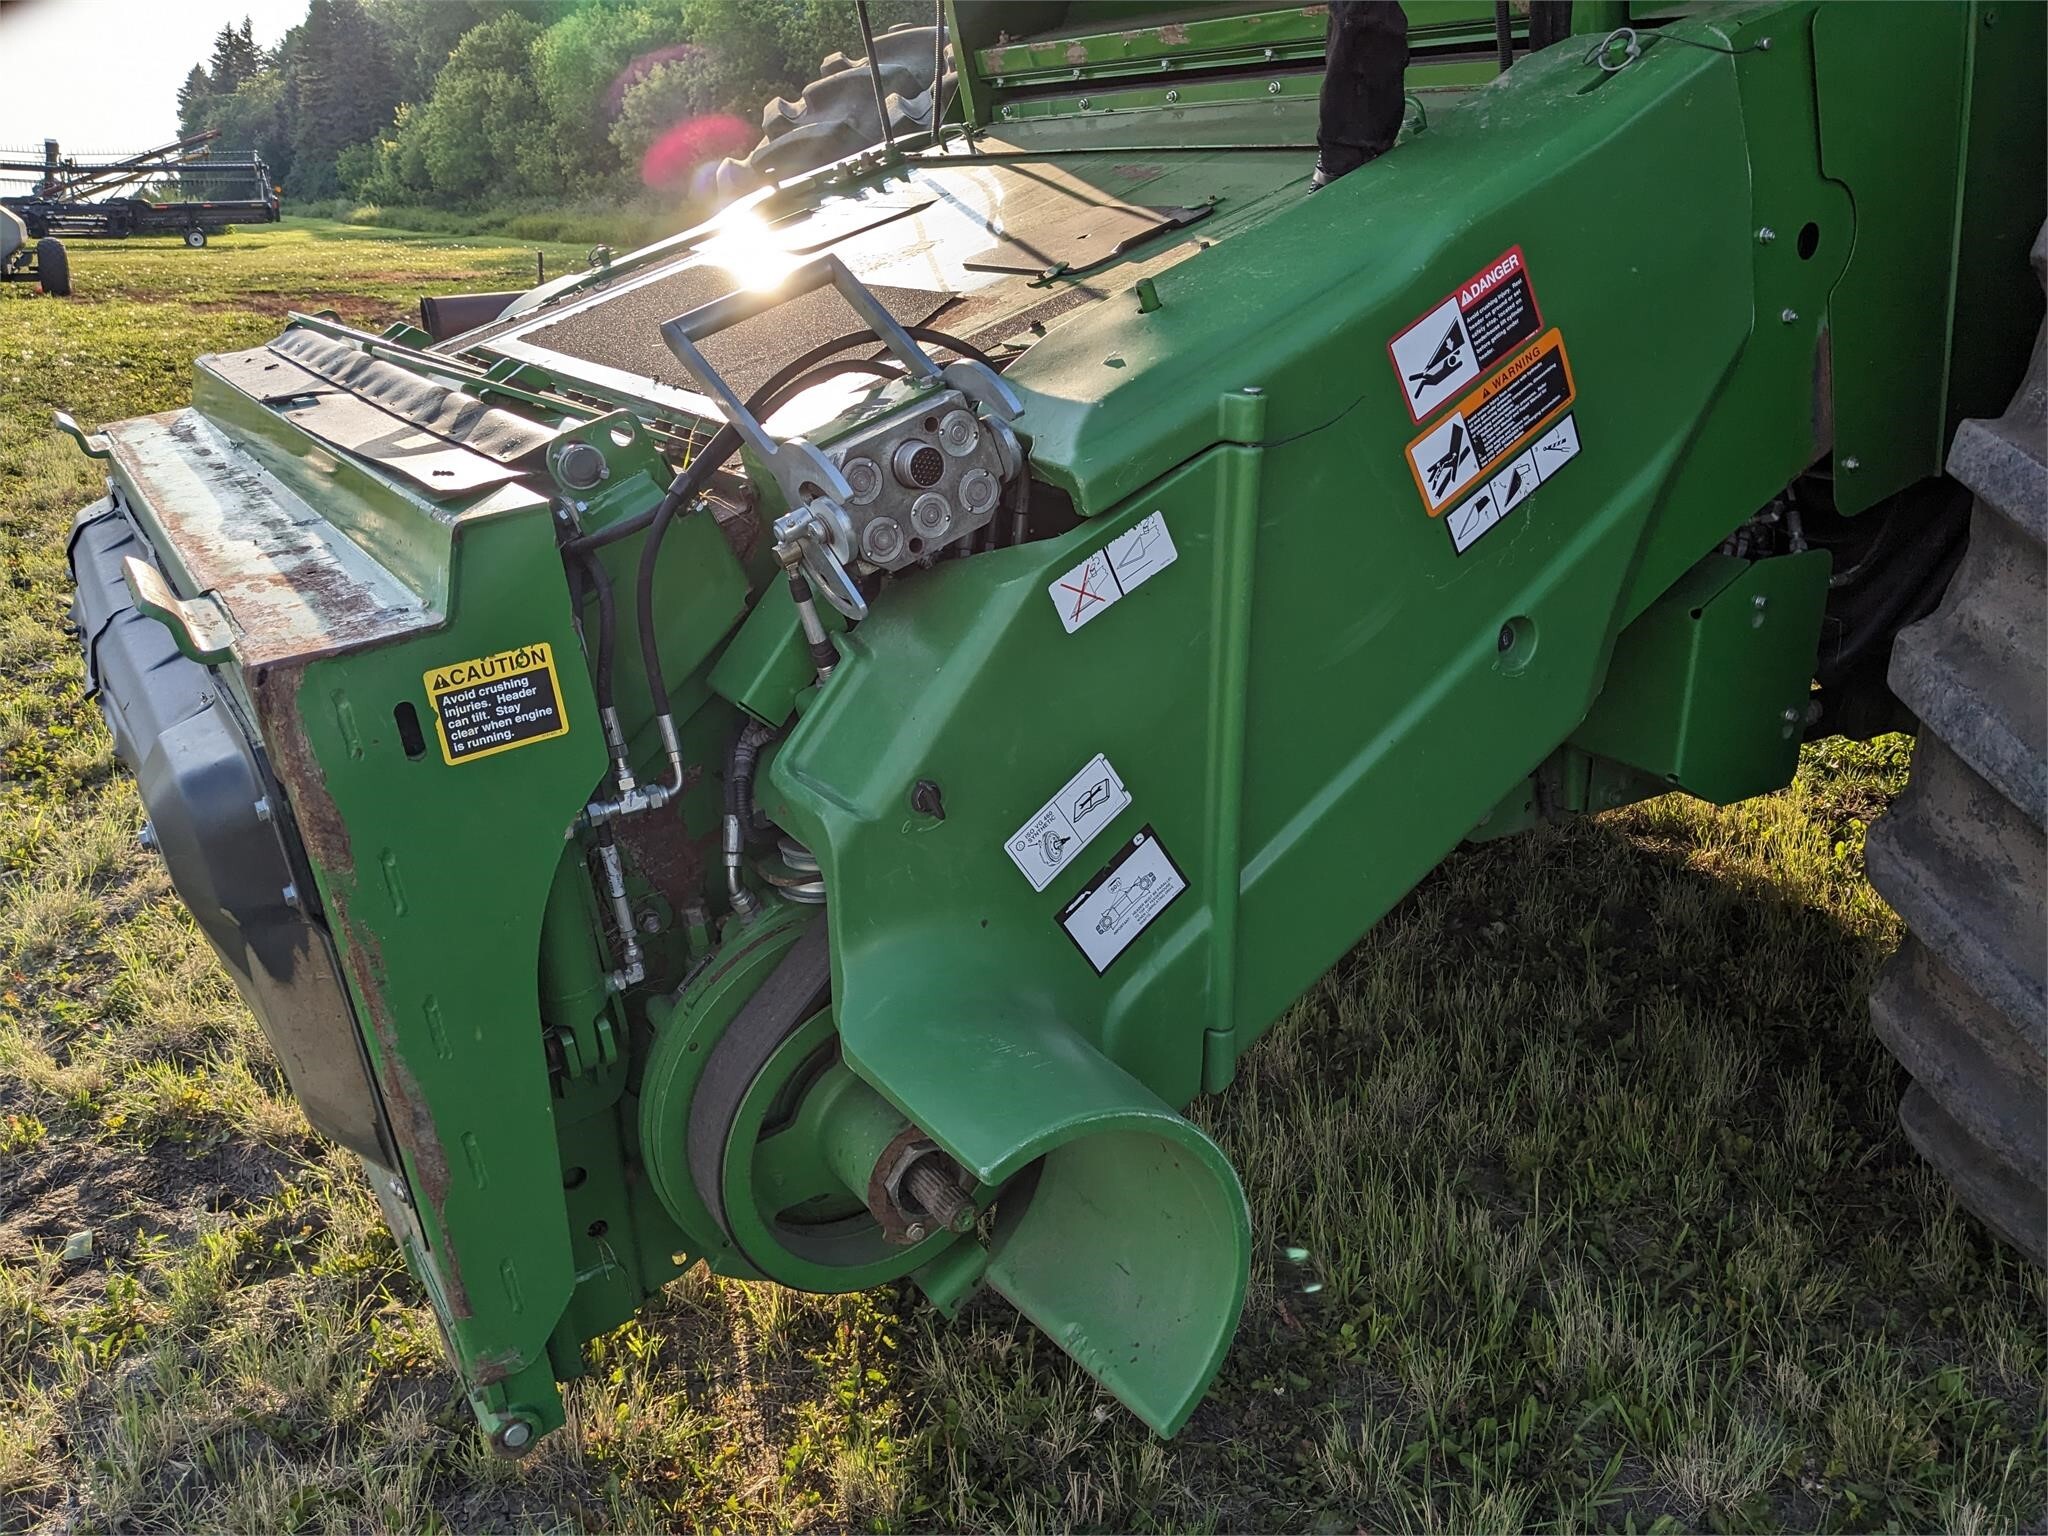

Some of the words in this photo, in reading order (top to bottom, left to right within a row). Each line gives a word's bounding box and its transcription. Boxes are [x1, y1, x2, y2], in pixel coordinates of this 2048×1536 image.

[1470, 254, 1519, 298] DANGER
[1467, 310, 1479, 323] Avoid
[1492, 347, 1541, 388] WARNING
[450, 648, 546, 684] CAUTION
[442, 689, 476, 706] Avoid
[479, 677, 529, 696] crushing
[444, 701, 491, 718] injuries.
[496, 686, 536, 704] Header
[448, 716, 469, 729] can
[471, 710, 490, 724] tilt.
[496, 703, 521, 716] Stay
[451, 727, 479, 740] clear
[481, 717, 512, 733] when
[515, 706, 552, 723] engine
[454, 742, 465, 752] is
[467, 731, 515, 748] running.
